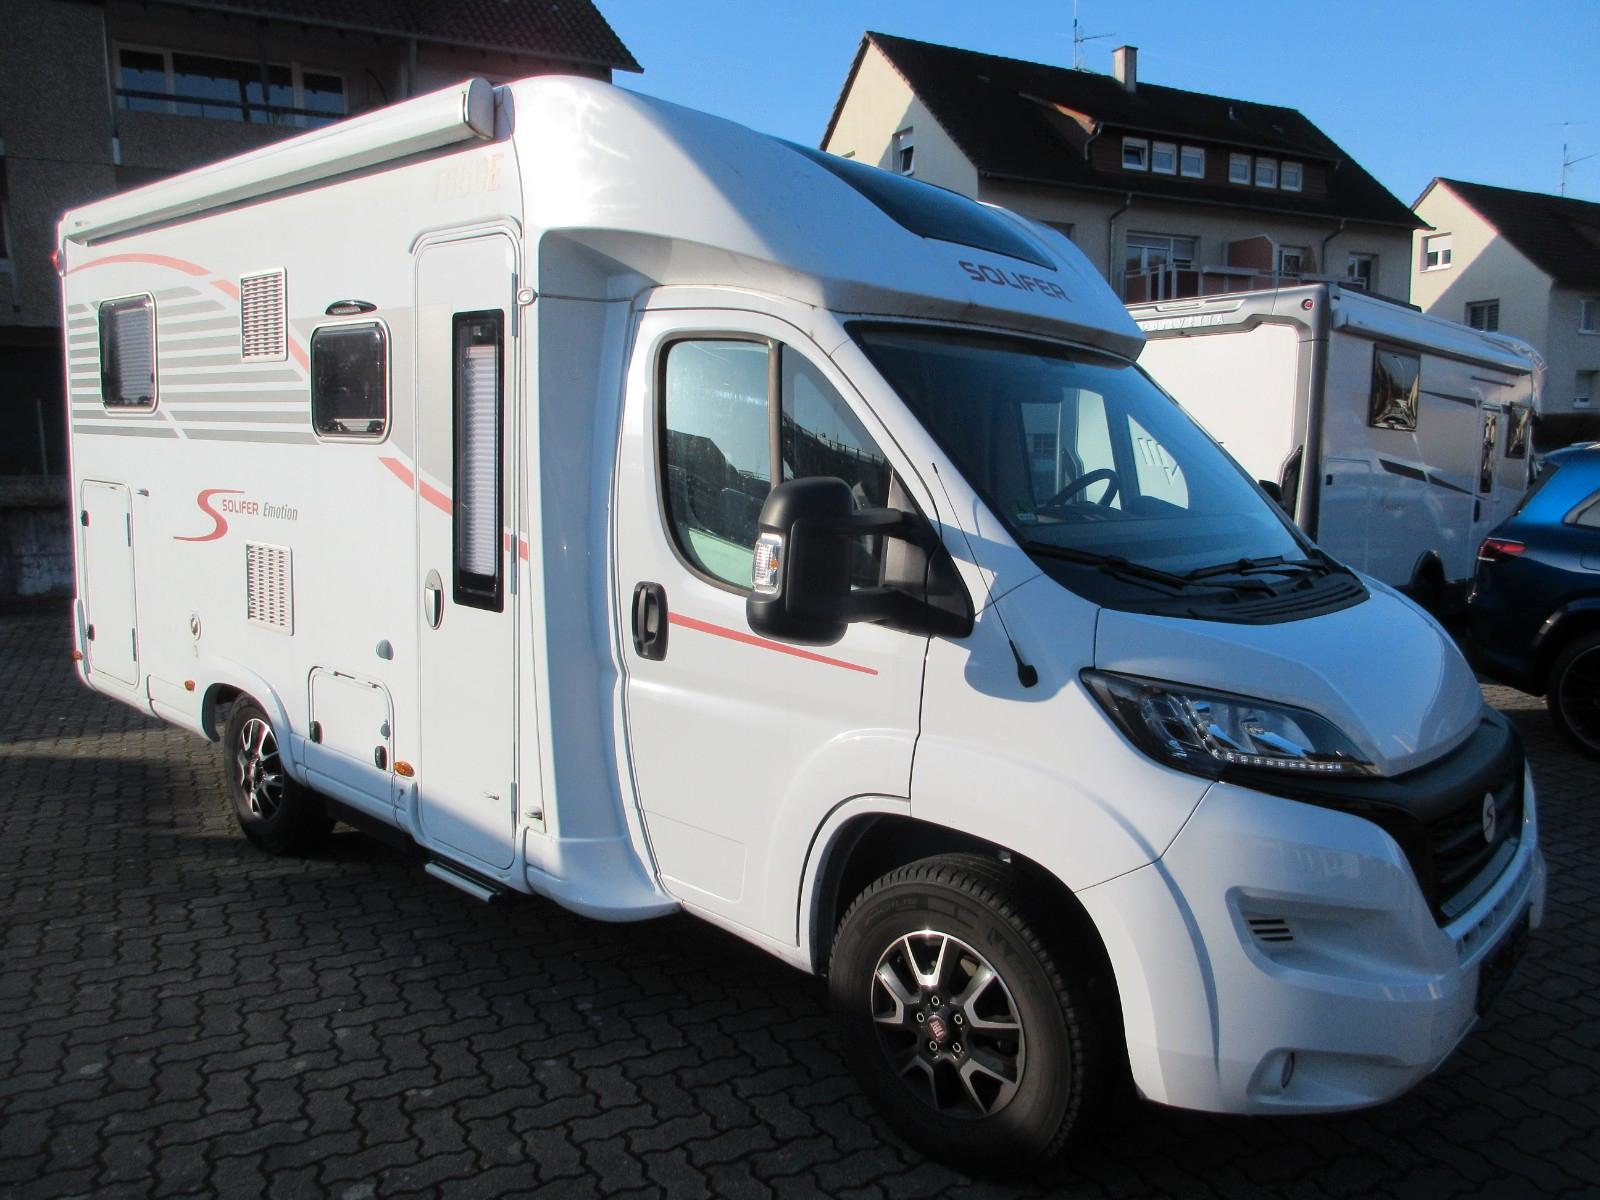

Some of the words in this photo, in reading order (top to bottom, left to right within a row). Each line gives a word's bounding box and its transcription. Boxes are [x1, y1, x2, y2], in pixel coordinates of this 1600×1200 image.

[959, 260, 1073, 303] SOLIFER
[222, 498, 260, 516] SOLIFER
[263, 501, 299, 521] Emotion
